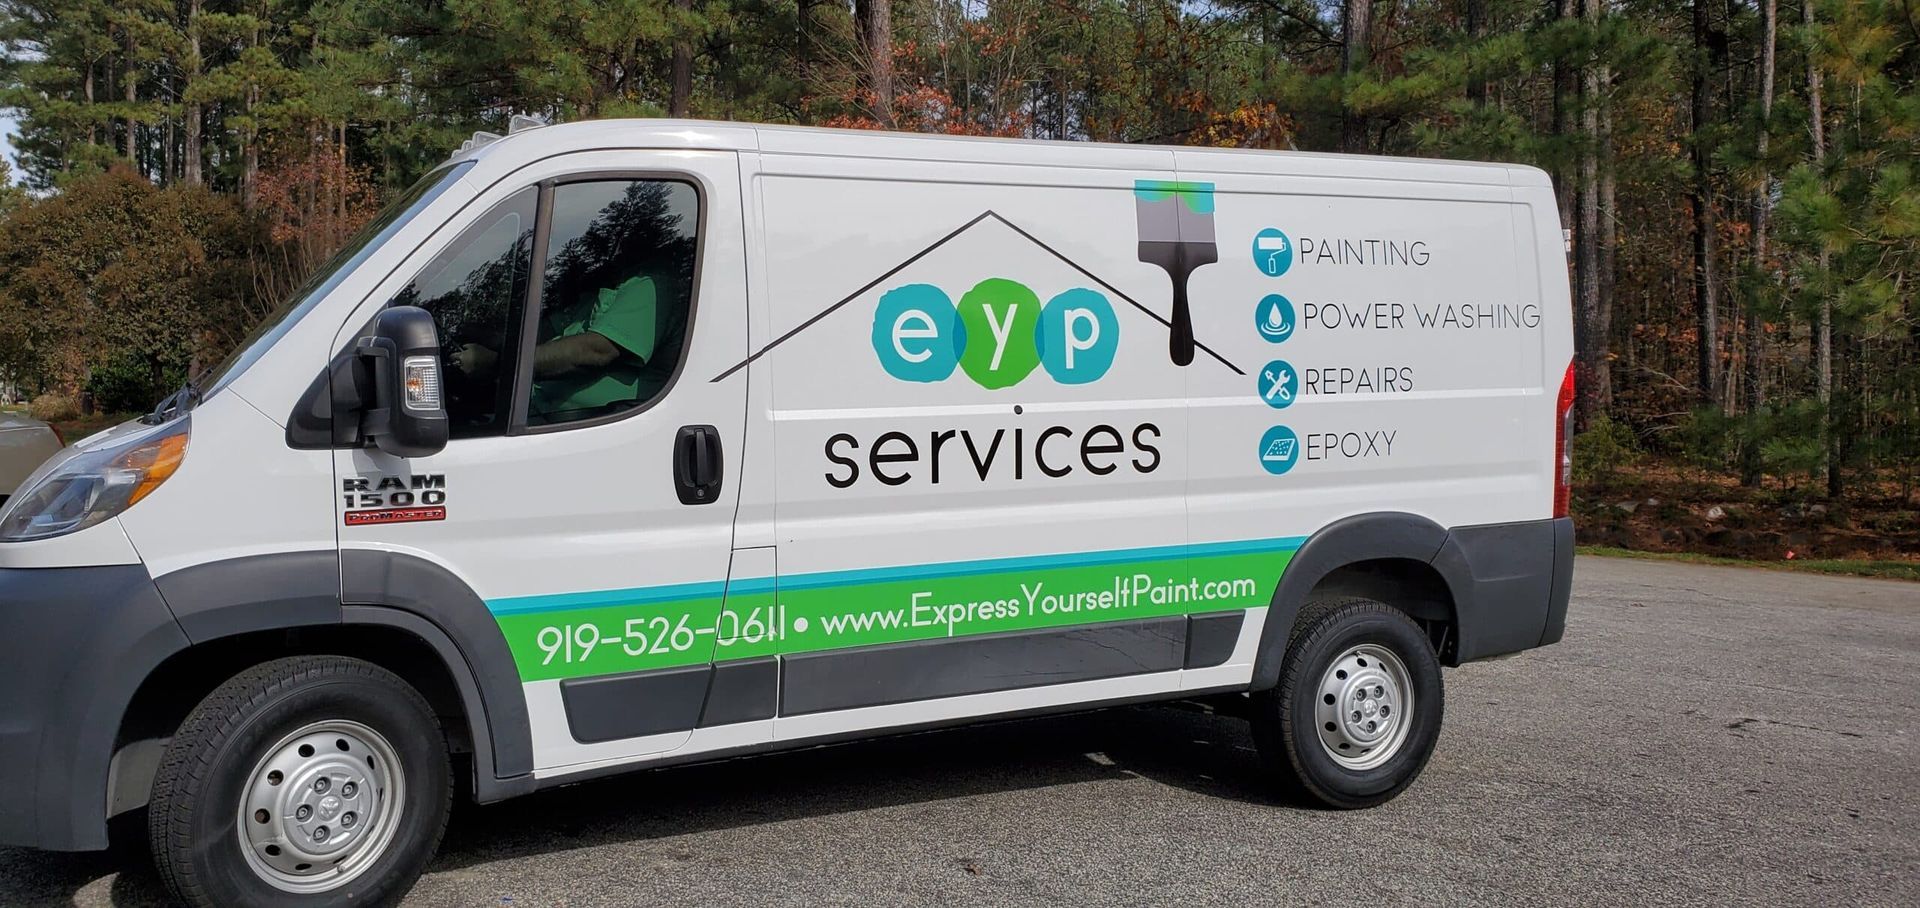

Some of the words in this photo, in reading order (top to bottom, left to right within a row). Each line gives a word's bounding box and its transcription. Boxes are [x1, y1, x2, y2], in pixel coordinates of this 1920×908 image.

[1300, 238, 1431, 266] PAINTING
[1304, 303, 1405, 329] POWER
[1413, 303, 1542, 329] WASHING
[891, 303, 1100, 371] eyp
[1305, 367, 1414, 395] REPAIRS
[824, 404, 1162, 489] services
[1307, 430, 1397, 460] EPOXY
[343, 474, 446, 492] RAM
[343, 490, 446, 508] 1500
[536, 604, 786, 666] 919-526-0611
[820, 573, 1256, 638] www.ExpressYourselfPaint.com
